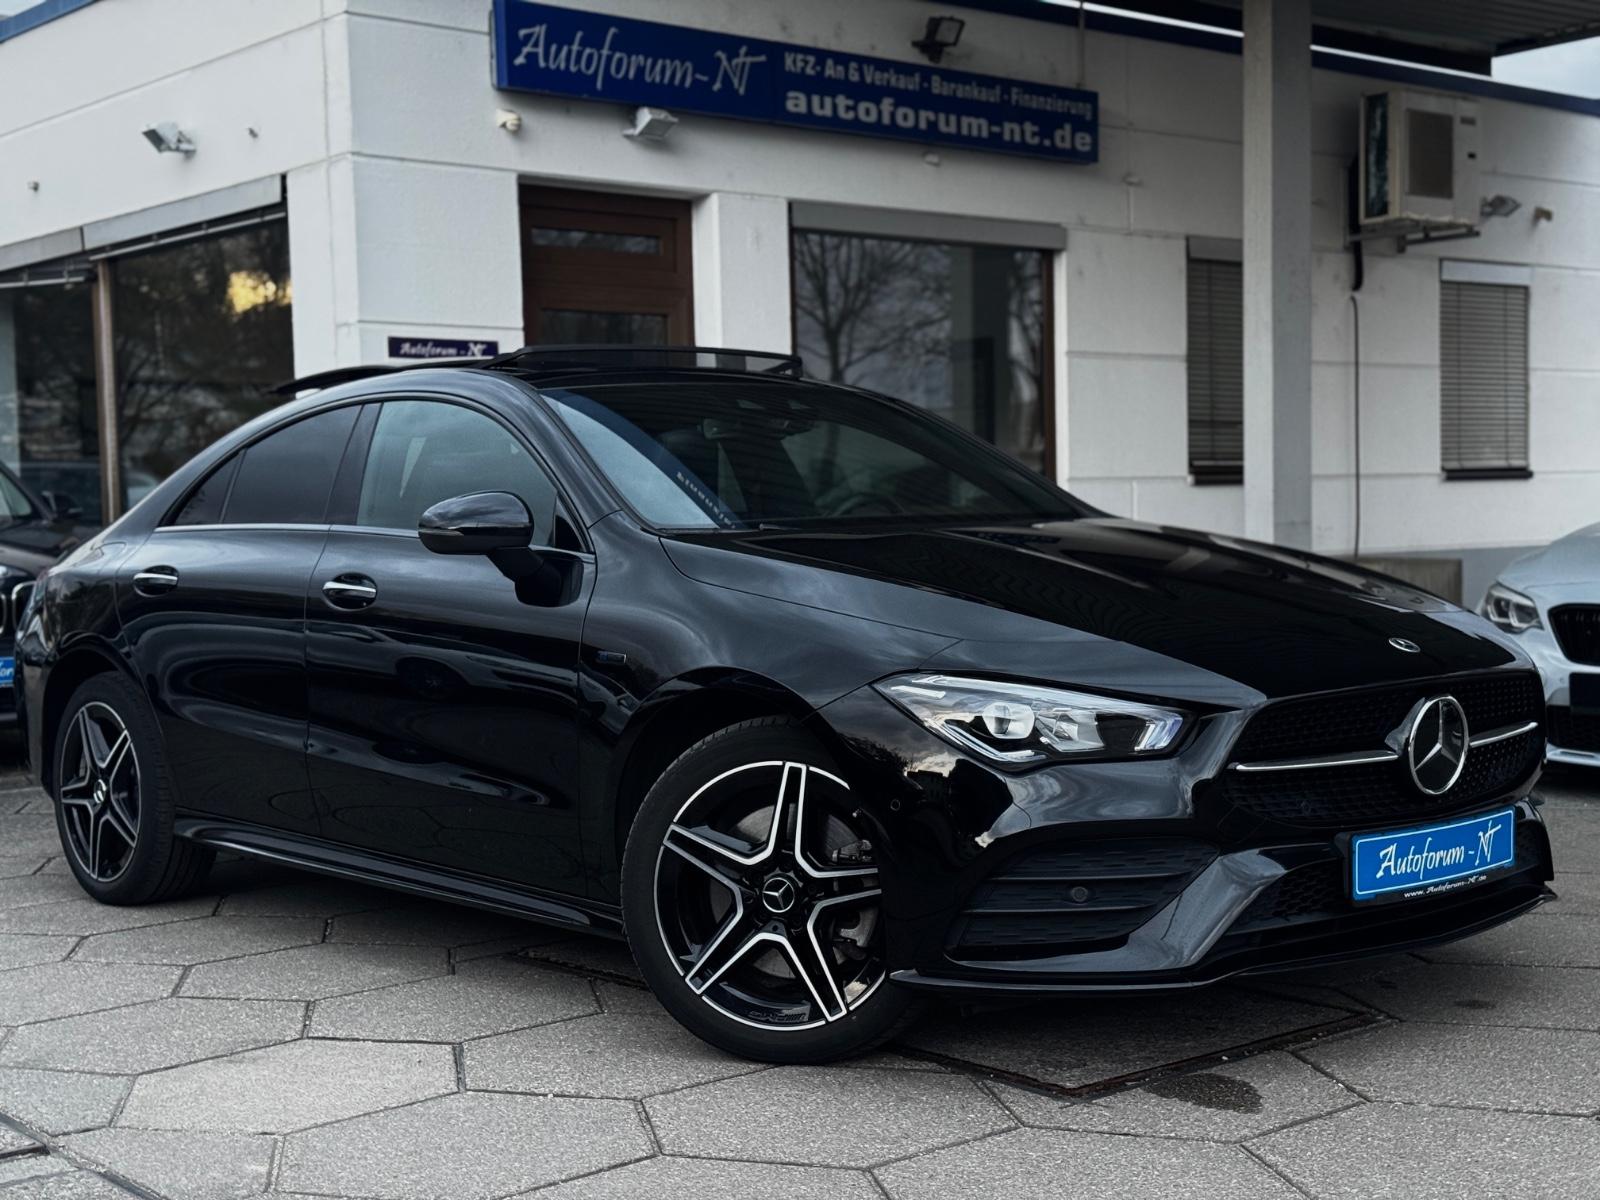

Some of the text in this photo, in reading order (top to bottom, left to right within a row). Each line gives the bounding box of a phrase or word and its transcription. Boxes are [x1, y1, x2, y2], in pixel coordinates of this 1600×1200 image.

[825, 57, 845, 80] An
[848, 61, 860, 83] &
[863, 64, 920, 91] Verkauf
[931, 74, 1001, 103] Barankauf
[1011, 86, 1093, 121] Finanzierung
[785, 90, 1093, 151] autoforum-nt.de
